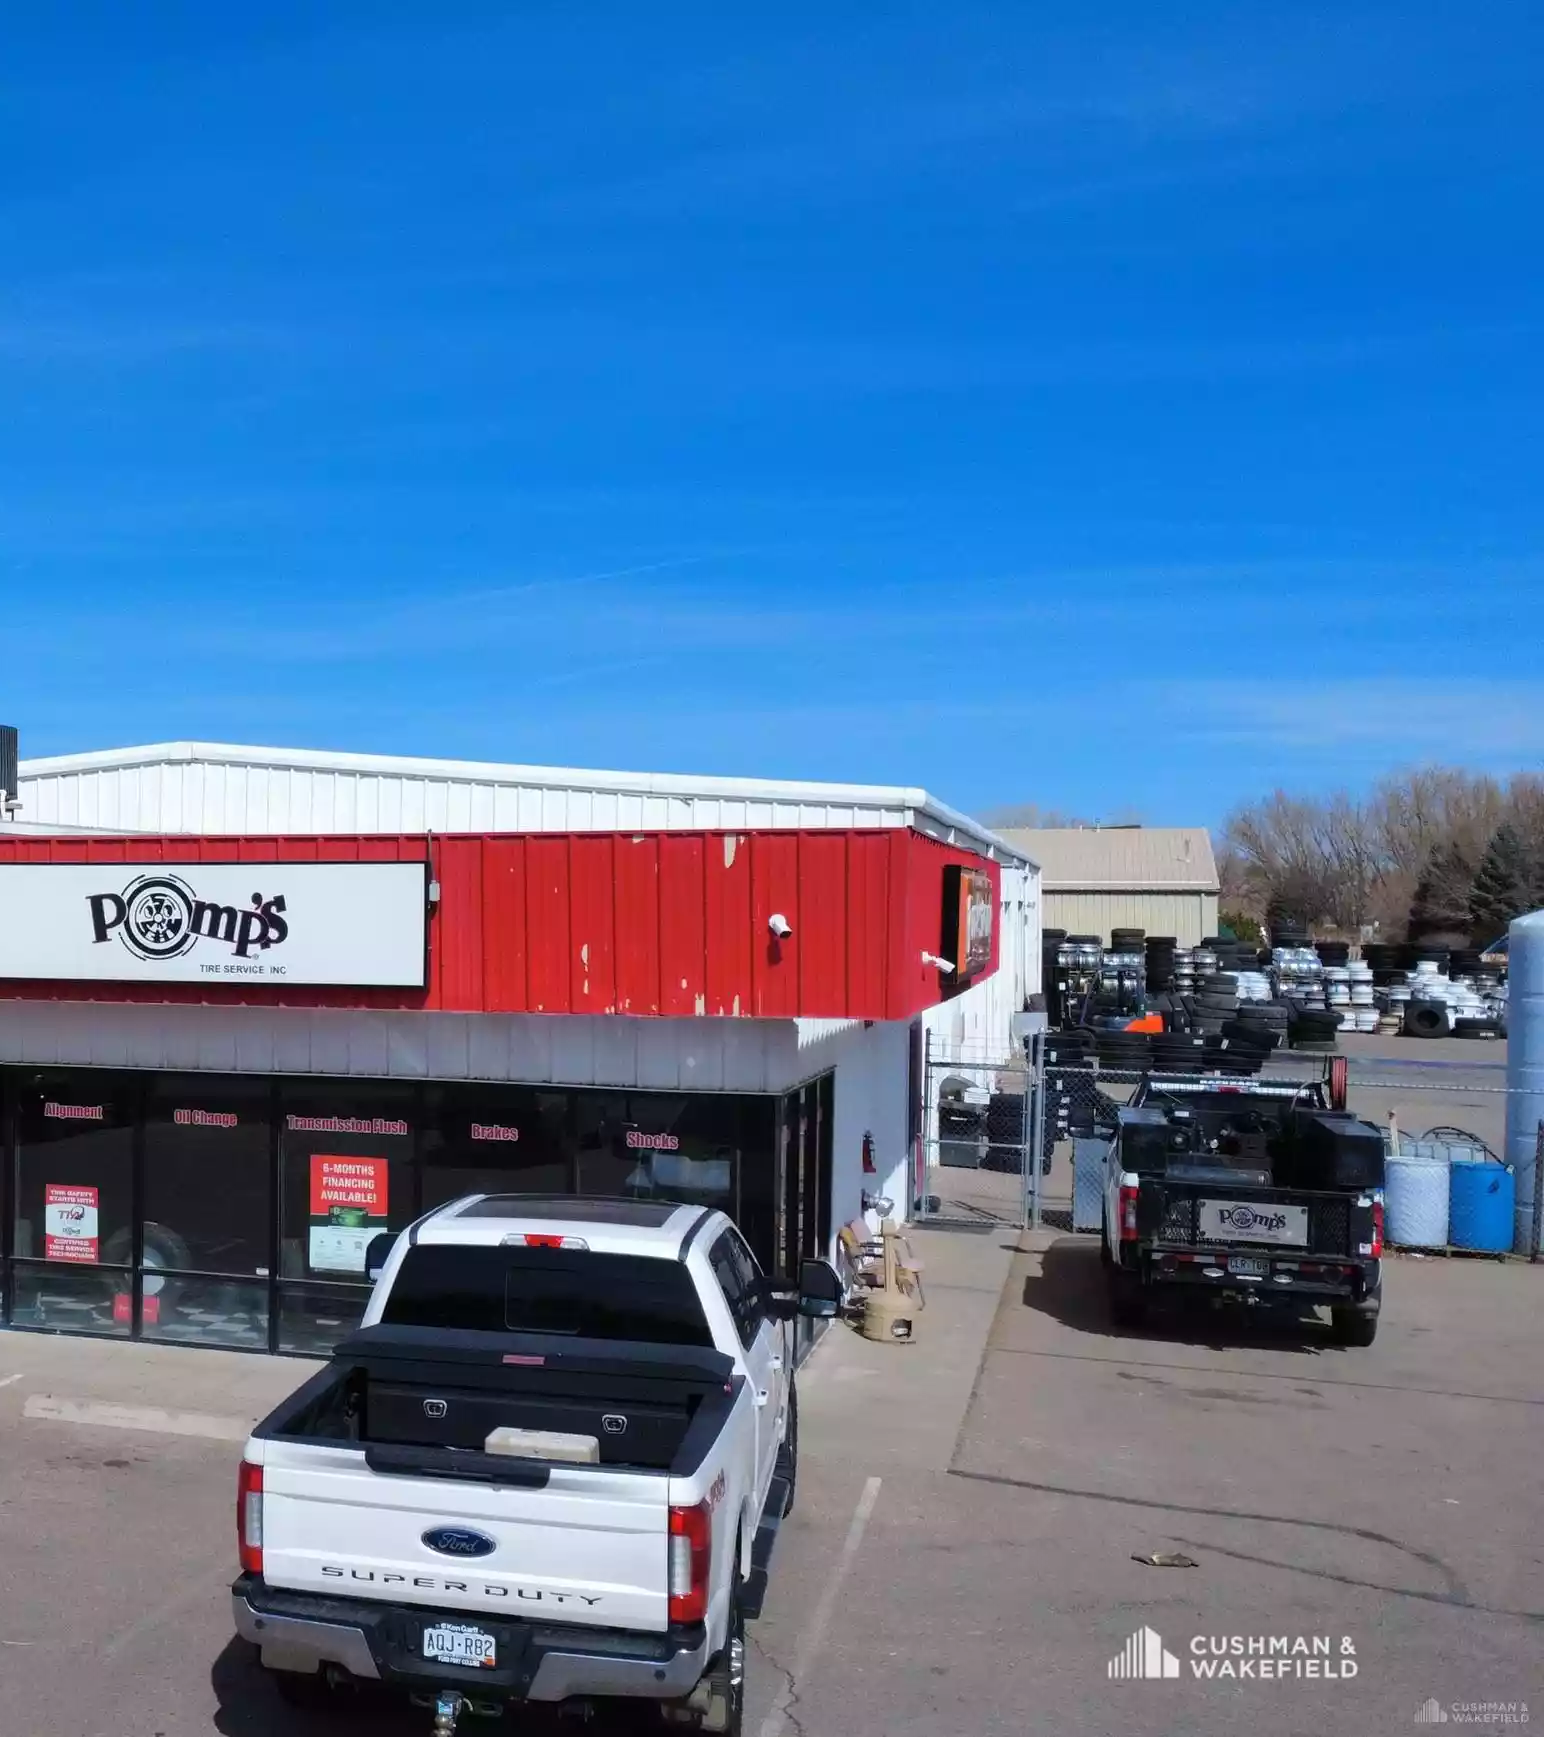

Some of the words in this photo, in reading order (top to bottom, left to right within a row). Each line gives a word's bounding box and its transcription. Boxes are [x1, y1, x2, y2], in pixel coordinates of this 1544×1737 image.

[85, 874, 288, 960] Pomp's
[199, 964, 221, 974] TIRE
[223, 964, 265, 975] SERVICE
[270, 965, 287, 975] INC
[44, 1102, 104, 1120] Alignment
[173, 1109, 191, 1125] Oil
[191, 1109, 238, 1128] Change
[286, 1115, 372, 1134] Transmission
[372, 1119, 408, 1135] Flush
[470, 1123, 519, 1142] Brakes
[625, 1131, 679, 1150] Shocks
[322, 1163, 375, 1176] 6-MONTHS
[322, 1176, 375, 1190] FINANCING
[320, 1190, 377, 1204] AVAILABLE!
[438, 1532, 481, 1552] Ford
[320, 1566, 468, 1593] SUPER
[484, 1583, 603, 1606] DUTY
